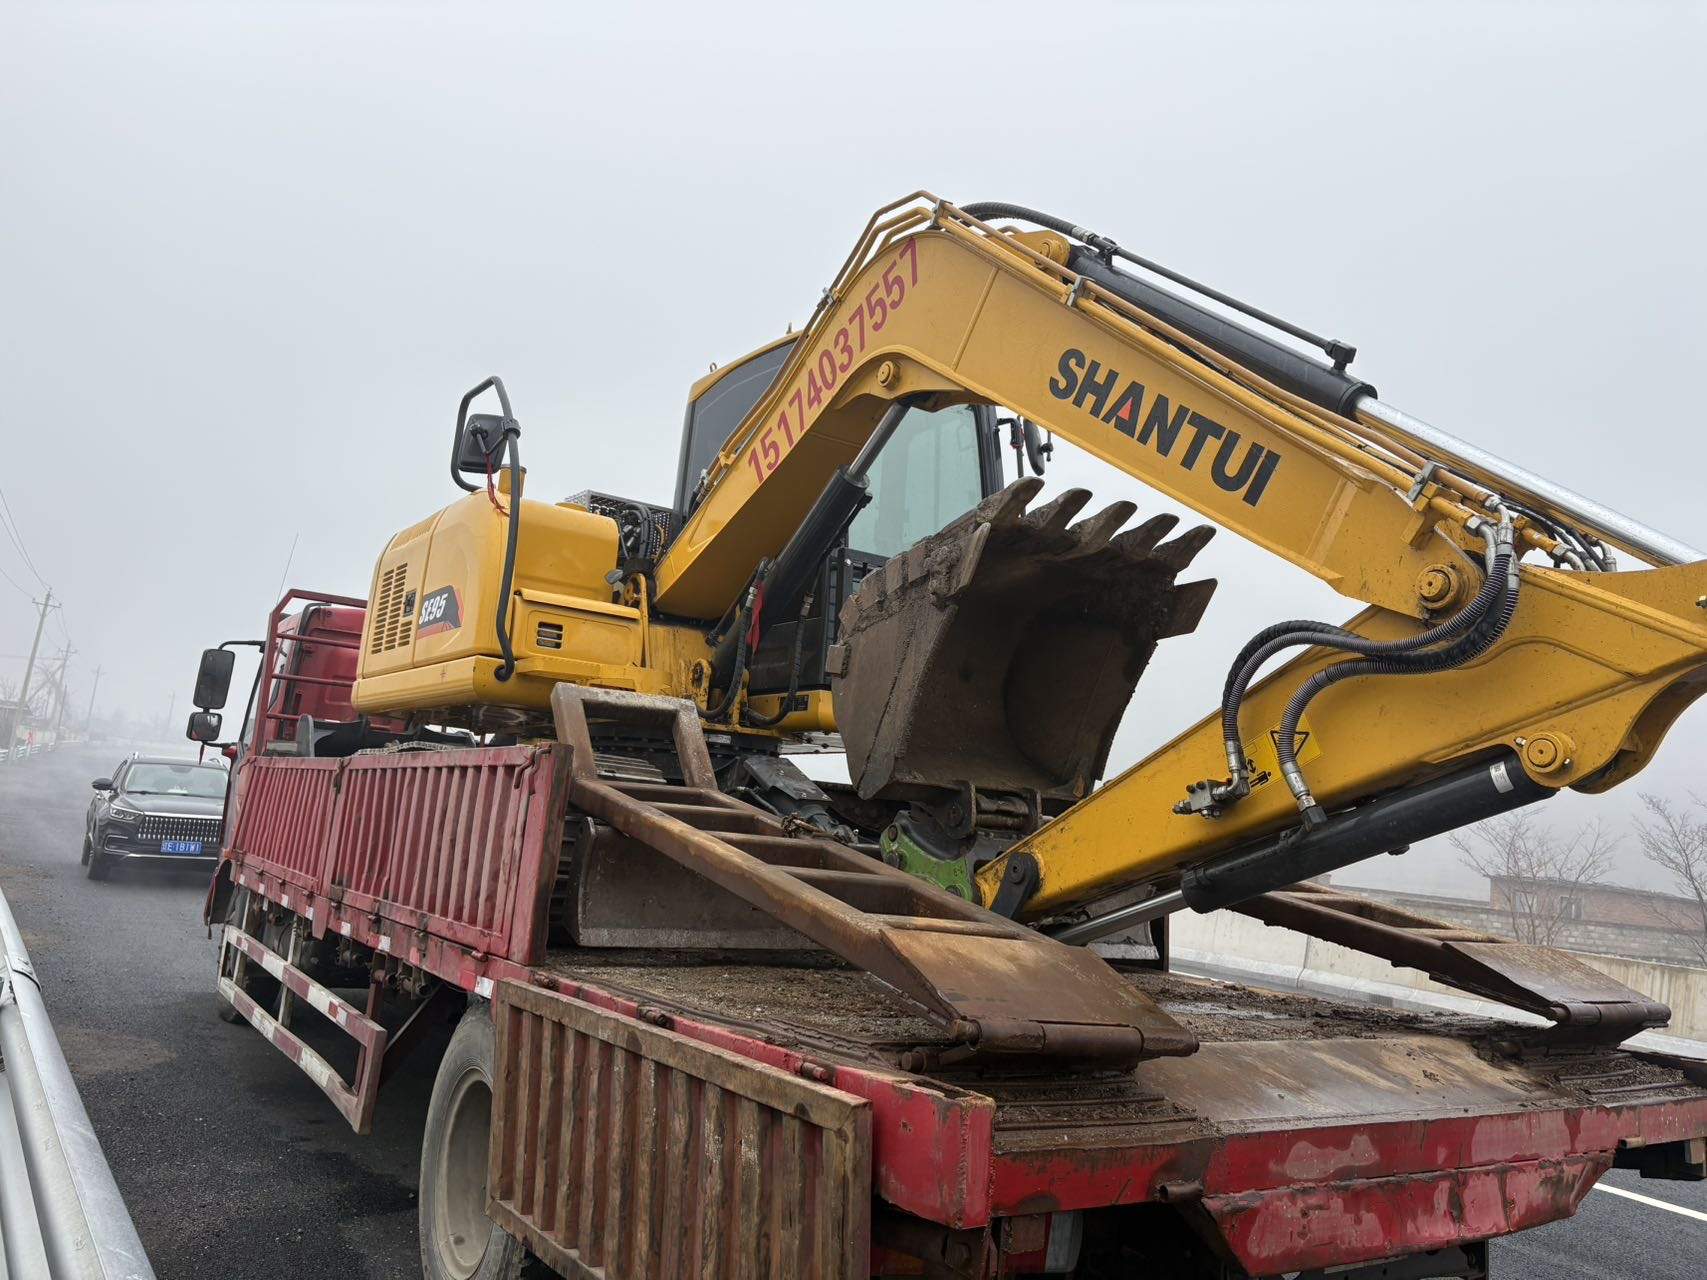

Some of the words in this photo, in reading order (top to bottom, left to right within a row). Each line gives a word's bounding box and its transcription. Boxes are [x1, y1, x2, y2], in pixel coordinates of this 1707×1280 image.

[748, 237, 918, 484] 15174037557
[1049, 348, 1281, 507] SHANTUI
[419, 593, 448, 625] SE95
